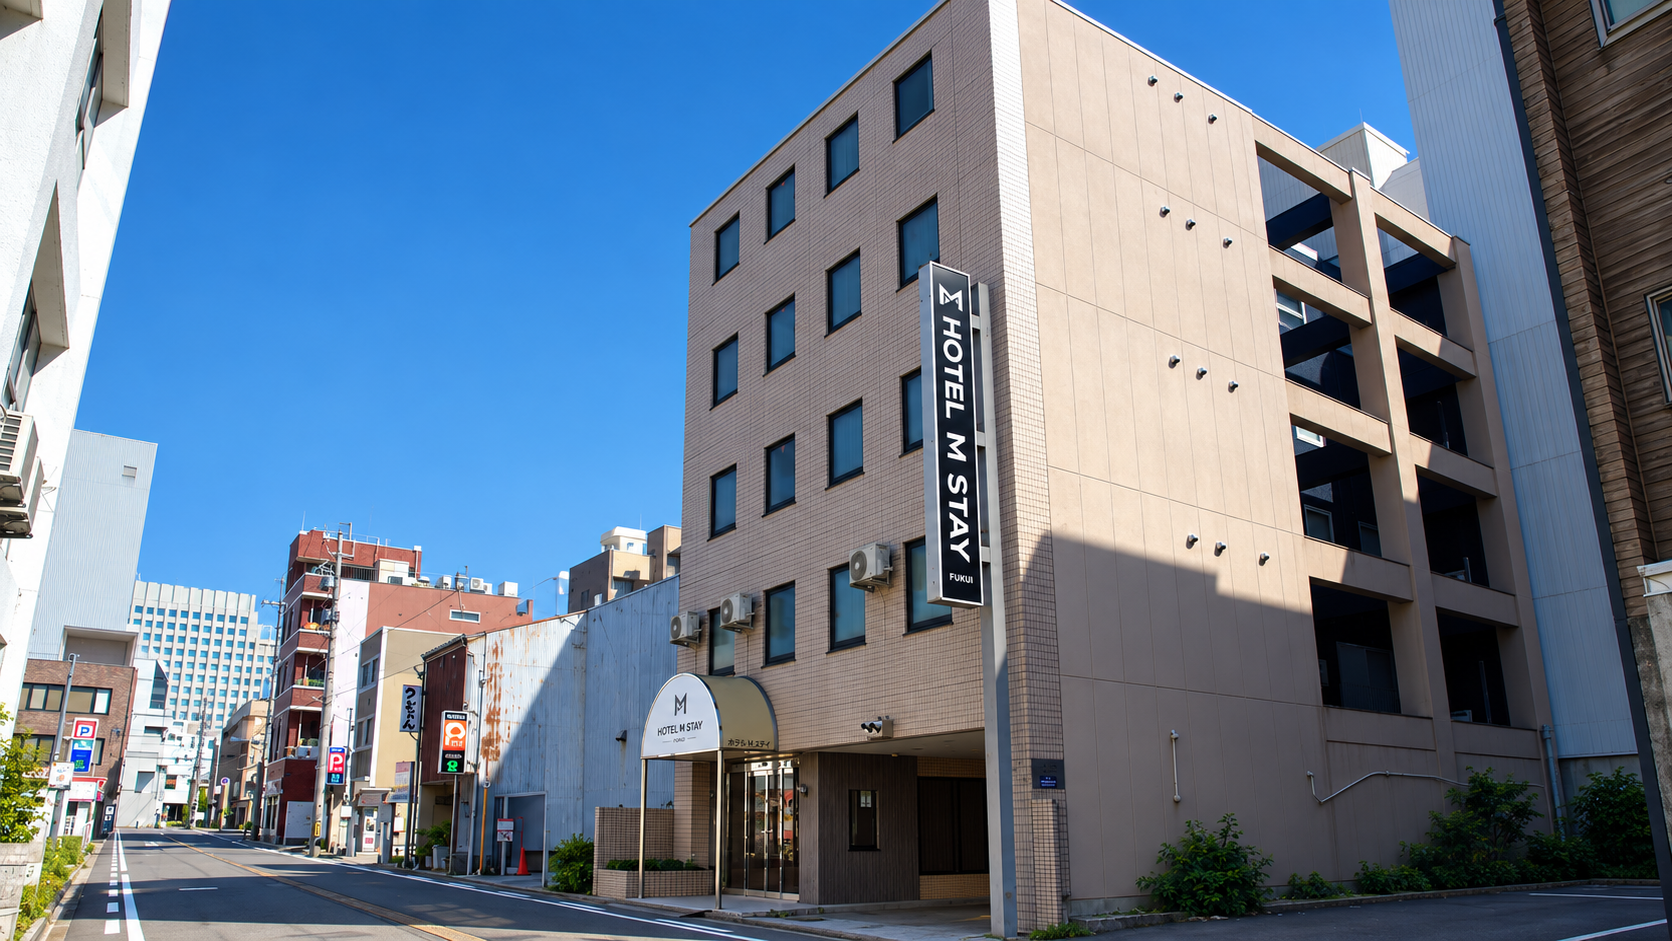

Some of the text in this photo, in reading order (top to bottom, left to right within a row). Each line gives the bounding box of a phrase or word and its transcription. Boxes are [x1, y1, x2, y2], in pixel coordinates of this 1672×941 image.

[942, 315, 965, 419] HOTEL
[946, 431, 967, 462] M
[947, 473, 971, 563] STAY
[949, 572, 974, 584] FUKUI
[80, 726, 90, 736] P
[657, 725, 679, 736] HOTEL
[686, 720, 704, 732] STAY
[329, 753, 344, 772] P
